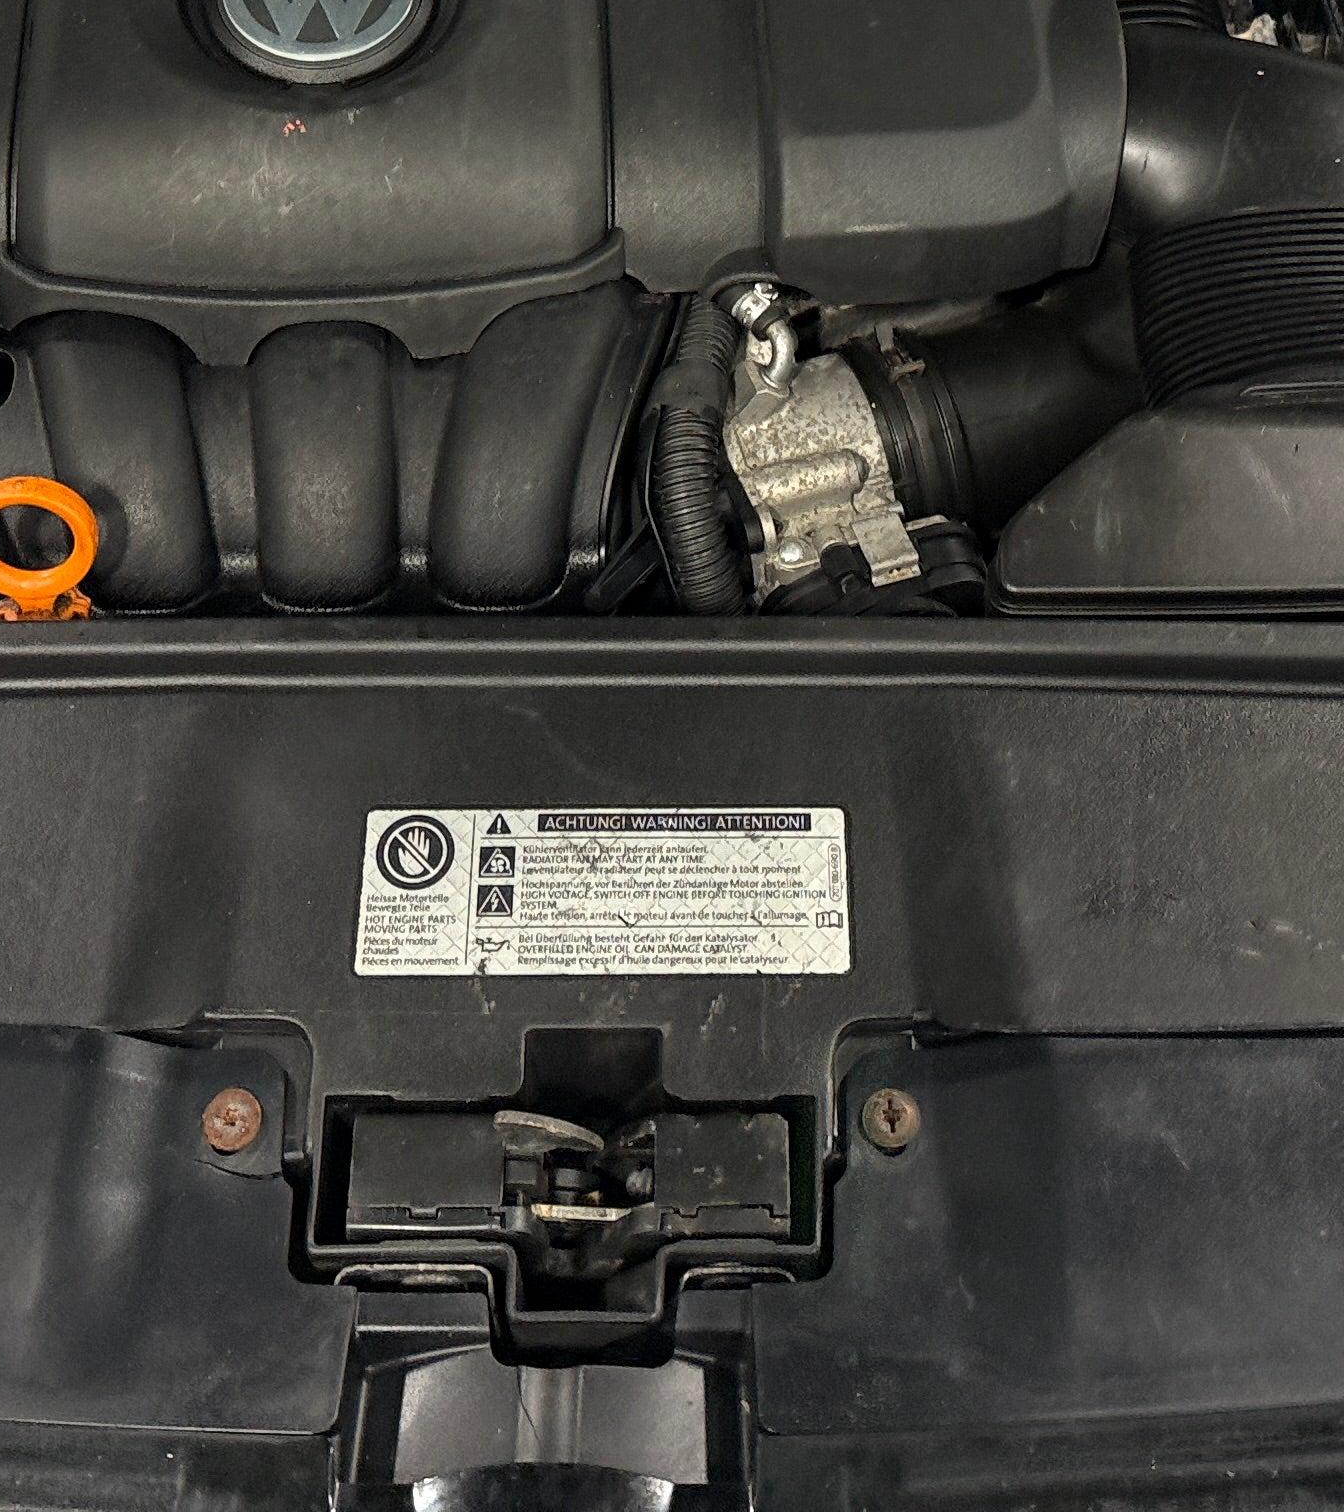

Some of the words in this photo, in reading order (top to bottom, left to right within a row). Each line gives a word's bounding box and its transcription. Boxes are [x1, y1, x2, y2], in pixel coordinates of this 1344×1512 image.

[544, 814, 626, 830] ACHTUNG!
[632, 814, 711, 830] WARNING!
[715, 814, 805, 830] ATTENTION!
[624, 843, 664, 855] jederzeit
[522, 855, 568, 864] RADIATOR
[571, 855, 590, 864] FAN
[593, 855, 613, 864] MAY
[616, 855, 643, 864] START
[645, 855, 657, 864] AT
[659, 855, 680, 864] ANY
[644, 865, 665, 876] peut
[739, 865, 759, 874] tout
[656, 880, 671, 889] der
[673, 880, 728, 890] Zündanlage
[730, 879, 759, 889] Motor
[367, 893, 398, 903] Heisse
[399, 893, 449, 903] Motorteile
[521, 890, 546, 899] HIGH
[594, 890, 631, 899] SWITCH
[633, 890, 651, 899] OFF
[653, 890, 689, 899] ENGINE
[691, 890, 726, 899] BEFORE
[728, 890, 781, 899] TOUCHING
[782, 890, 827, 899] IGNITION
[366, 903, 407, 914] Bewegte
[409, 903, 431, 912] Teile
[365, 915, 386, 924] HOT
[388, 915, 425, 924] ENGINE
[427, 915, 457, 924] PARTS
[519, 911, 548, 920] Haute
[633, 911, 668, 920] moteur
[669, 911, 697, 920] avant
[698, 910, 710, 920] de
[711, 910, 750, 920] toucher
[364, 925, 406, 934] MOVING
[408, 925, 438, 934] PARTS
[363, 936, 391, 945] Pièces
[391, 936, 404, 946] du
[405, 937, 438, 946] moteur
[518, 933, 533, 943] Bei
[535, 932, 593, 945] Überfüllung
[594, 933, 631, 943] besteht
[632, 933, 667, 943] Gefahr
[669, 933, 683, 942] für
[684, 933, 703, 942] den
[362, 946, 400, 955] chaudes
[518, 944, 574, 954] OVERFILLED
[575, 944, 612, 954] ENGINE
[634, 944, 655, 954] CAN
[657, 944, 701, 953] DAMAGE
[362, 957, 389, 966] Pièces
[390, 958, 403, 966] en
[404, 956, 459, 966] mouvement
[517, 955, 577, 967] Remplissage
[652, 955, 703, 966] dangereux
[705, 956, 728, 966] pour
